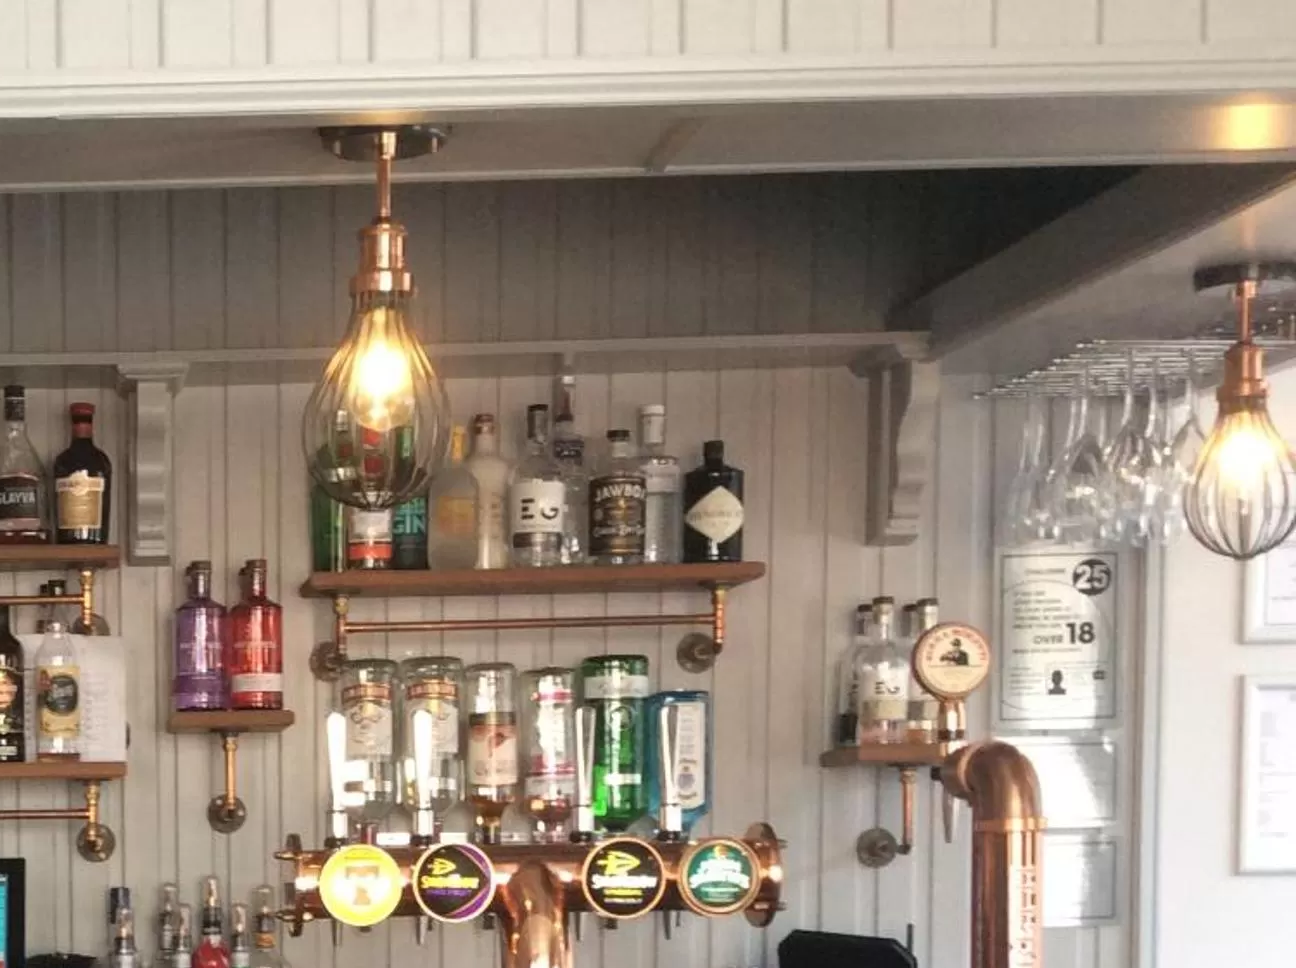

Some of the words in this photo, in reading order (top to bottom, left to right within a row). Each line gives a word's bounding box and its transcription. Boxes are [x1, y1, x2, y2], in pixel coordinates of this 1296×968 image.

[1074, 564, 1110, 590] 25
[1033, 635, 1064, 645] OVER
[1065, 621, 1096, 645] 18
